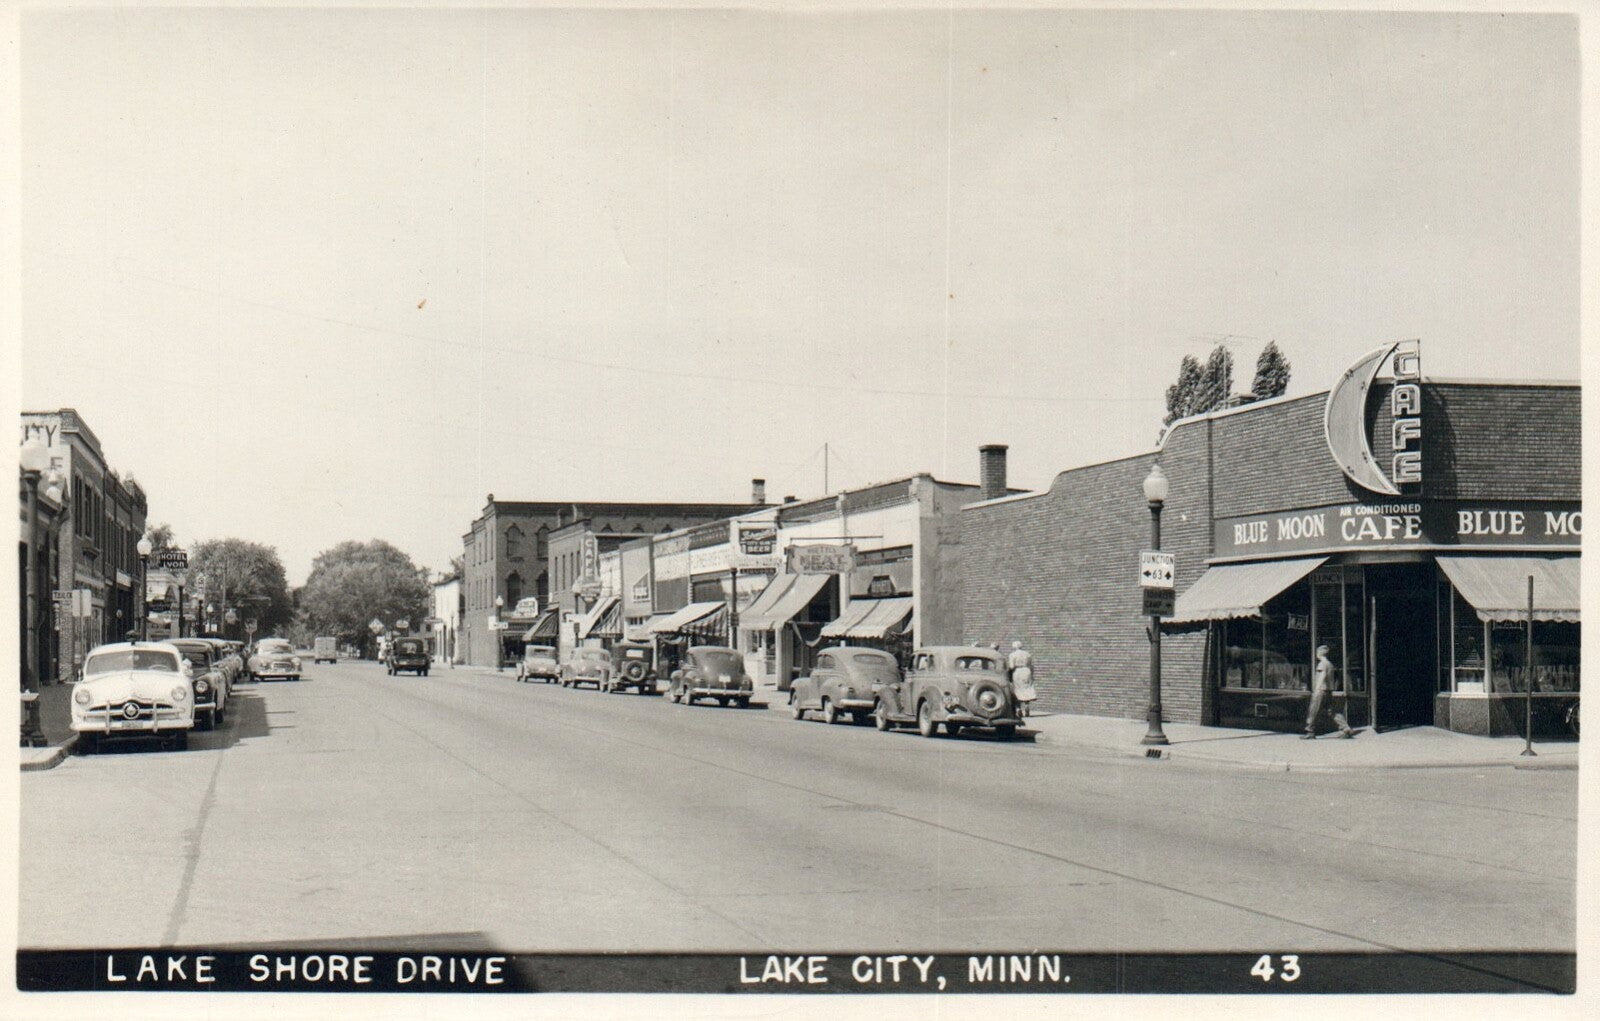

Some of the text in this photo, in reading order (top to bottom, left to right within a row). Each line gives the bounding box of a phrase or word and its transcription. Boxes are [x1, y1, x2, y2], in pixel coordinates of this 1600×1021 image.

[1392, 351, 1421, 483] CAFE
[1339, 504, 1422, 517] AIR CONDITIONED
[1234, 521, 1269, 545] BLUE
[1277, 514, 1326, 541] MOON
[1341, 515, 1422, 542] CAFE
[1458, 511, 1525, 535] BLUE
[585, 538, 594, 577] CAFE
[1142, 553, 1173, 564] JUNCTION
[1153, 569, 1162, 580] 63
